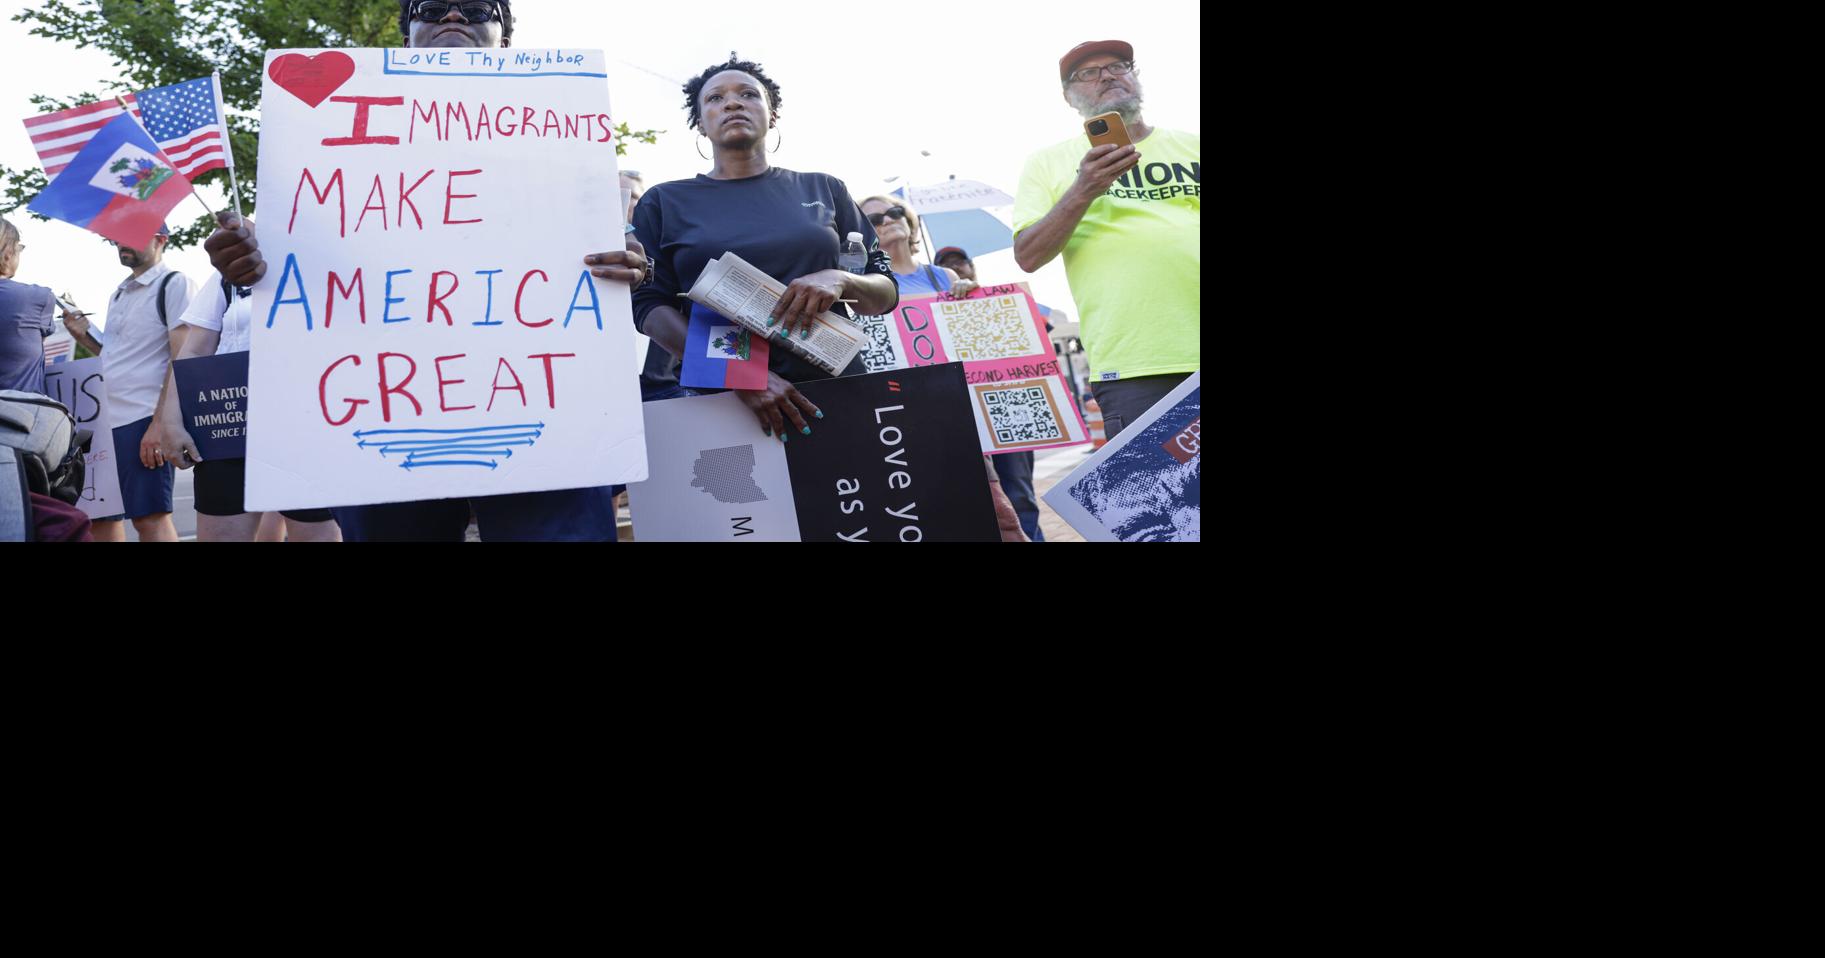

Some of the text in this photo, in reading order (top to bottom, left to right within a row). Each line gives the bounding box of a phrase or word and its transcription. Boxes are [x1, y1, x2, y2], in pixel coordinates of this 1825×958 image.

[392, 50, 450, 66] LOVE
[465, 52, 505, 72] Thy
[1110, 162, 1200, 188] NION
[288, 168, 483, 238] MAKE
[267, 253, 603, 331] AMERICA
[983, 284, 1016, 297] LAW
[901, 306, 937, 366] DO
[1007, 360, 1061, 378] HARVEST
[198, 391, 208, 403] A
[318, 352, 576, 426] GREAT
[224, 401, 238, 411] OF
[211, 427, 240, 439] SINCE
[836, 478, 864, 514] as
